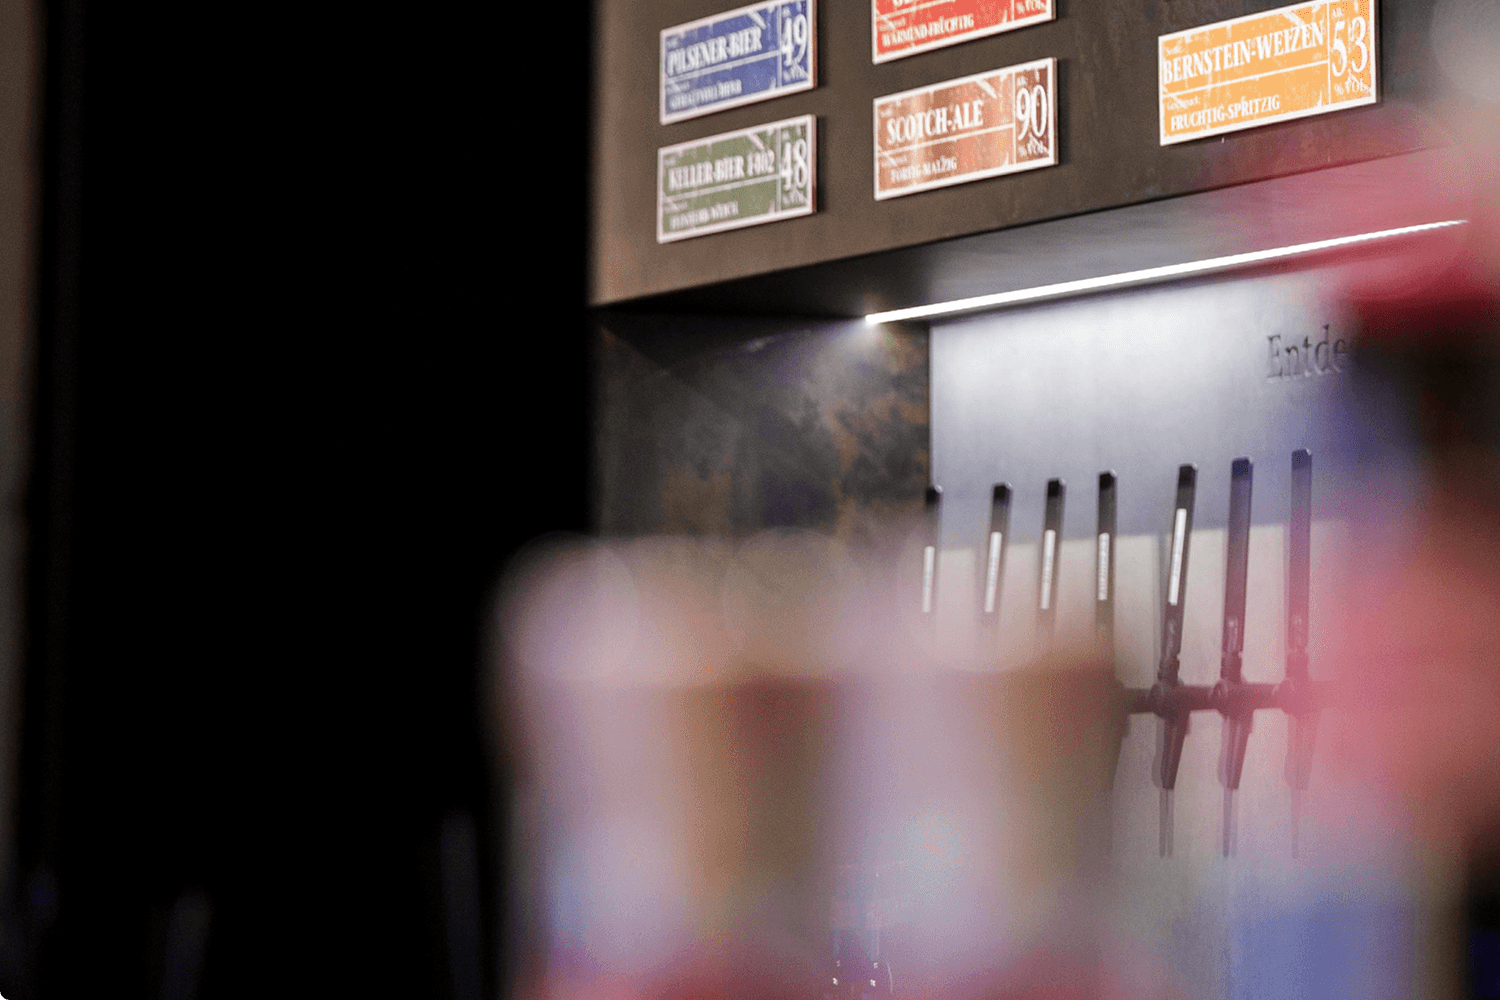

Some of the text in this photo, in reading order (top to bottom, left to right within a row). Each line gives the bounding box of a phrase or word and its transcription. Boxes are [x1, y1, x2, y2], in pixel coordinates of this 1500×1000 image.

[1164, 20, 1324, 84] BERNSTEIN-WEIZEN
[887, 100, 984, 145] SCOTCH-ALE
[1266, 324, 1348, 379] Entde
